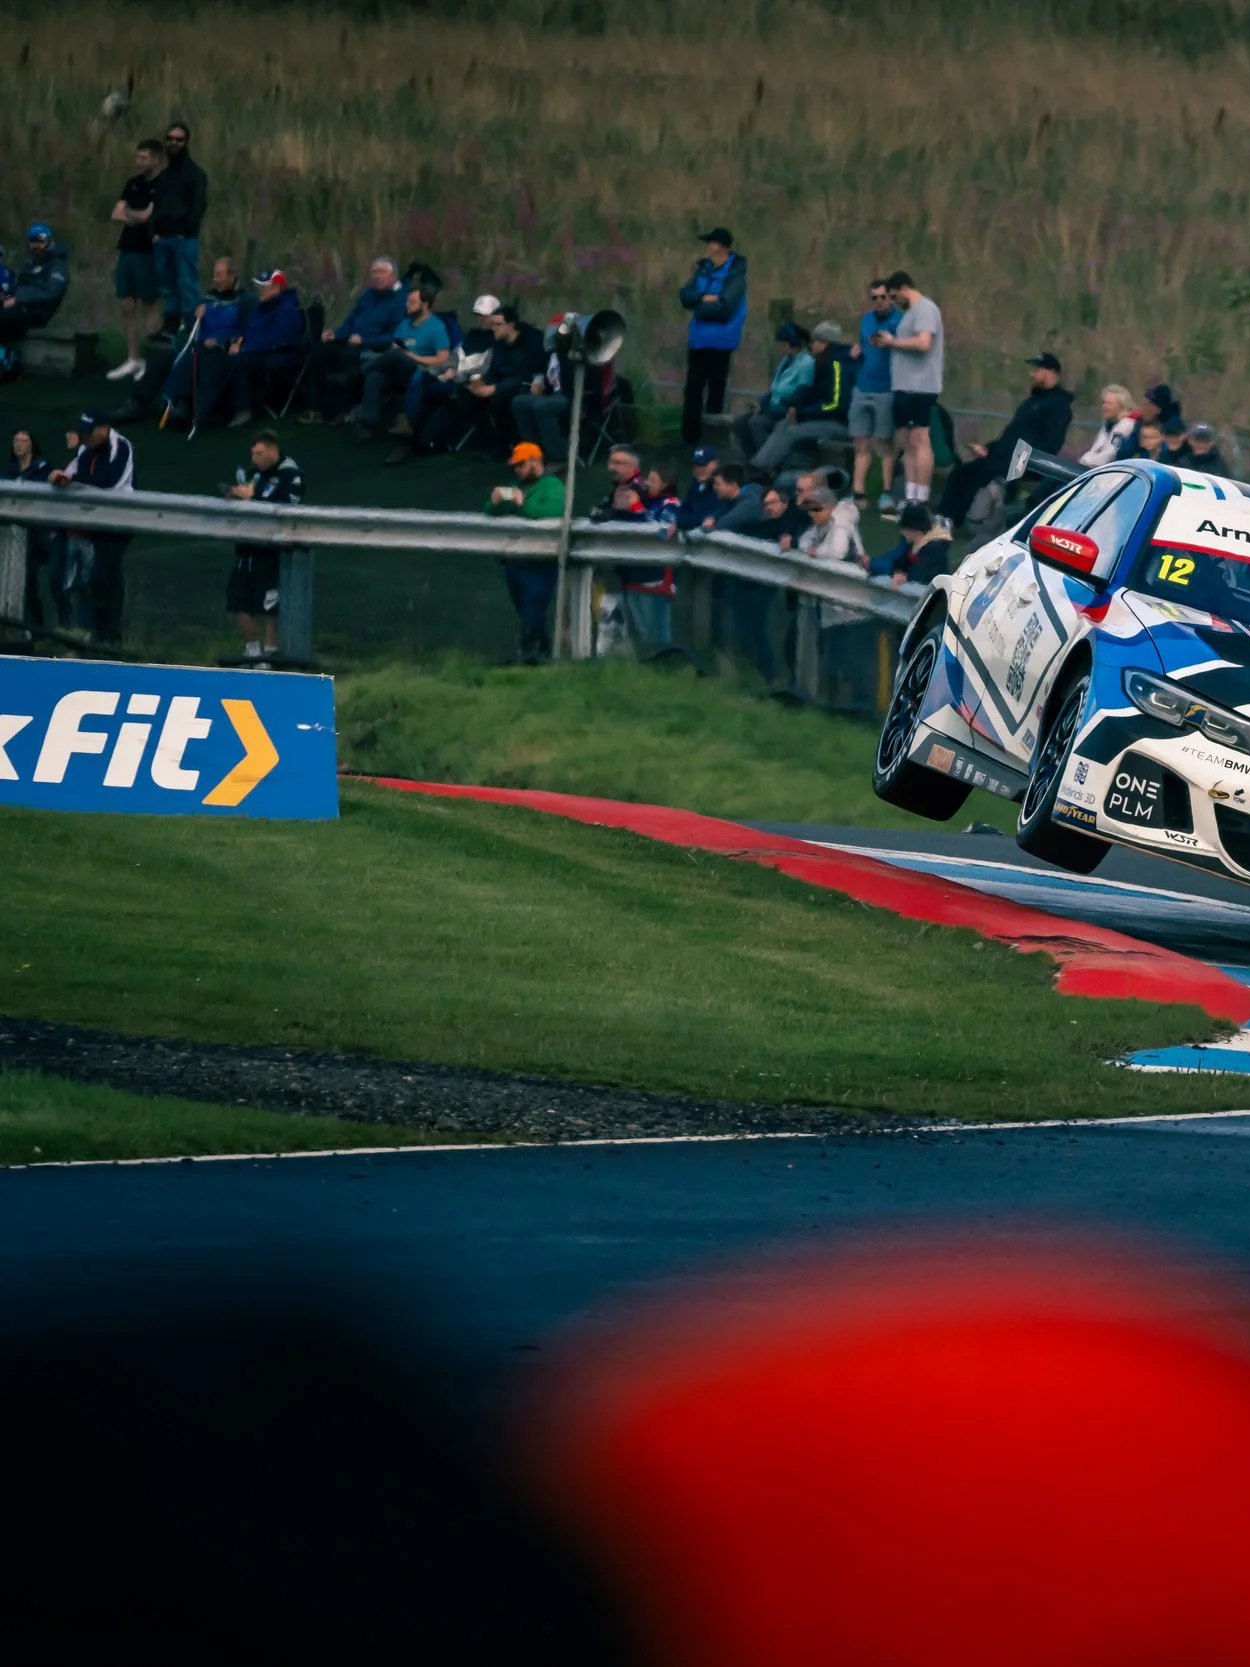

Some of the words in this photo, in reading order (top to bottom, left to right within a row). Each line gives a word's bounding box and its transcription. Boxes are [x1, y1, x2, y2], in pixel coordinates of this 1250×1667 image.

[1050, 534, 1083, 555] WSR
[1158, 554, 1196, 586] 12
[1115, 772, 1161, 800] ONE
[1109, 792, 1154, 820] PLM
[1233, 796, 1246, 804] TOW
[1164, 830, 1198, 847] WSR
